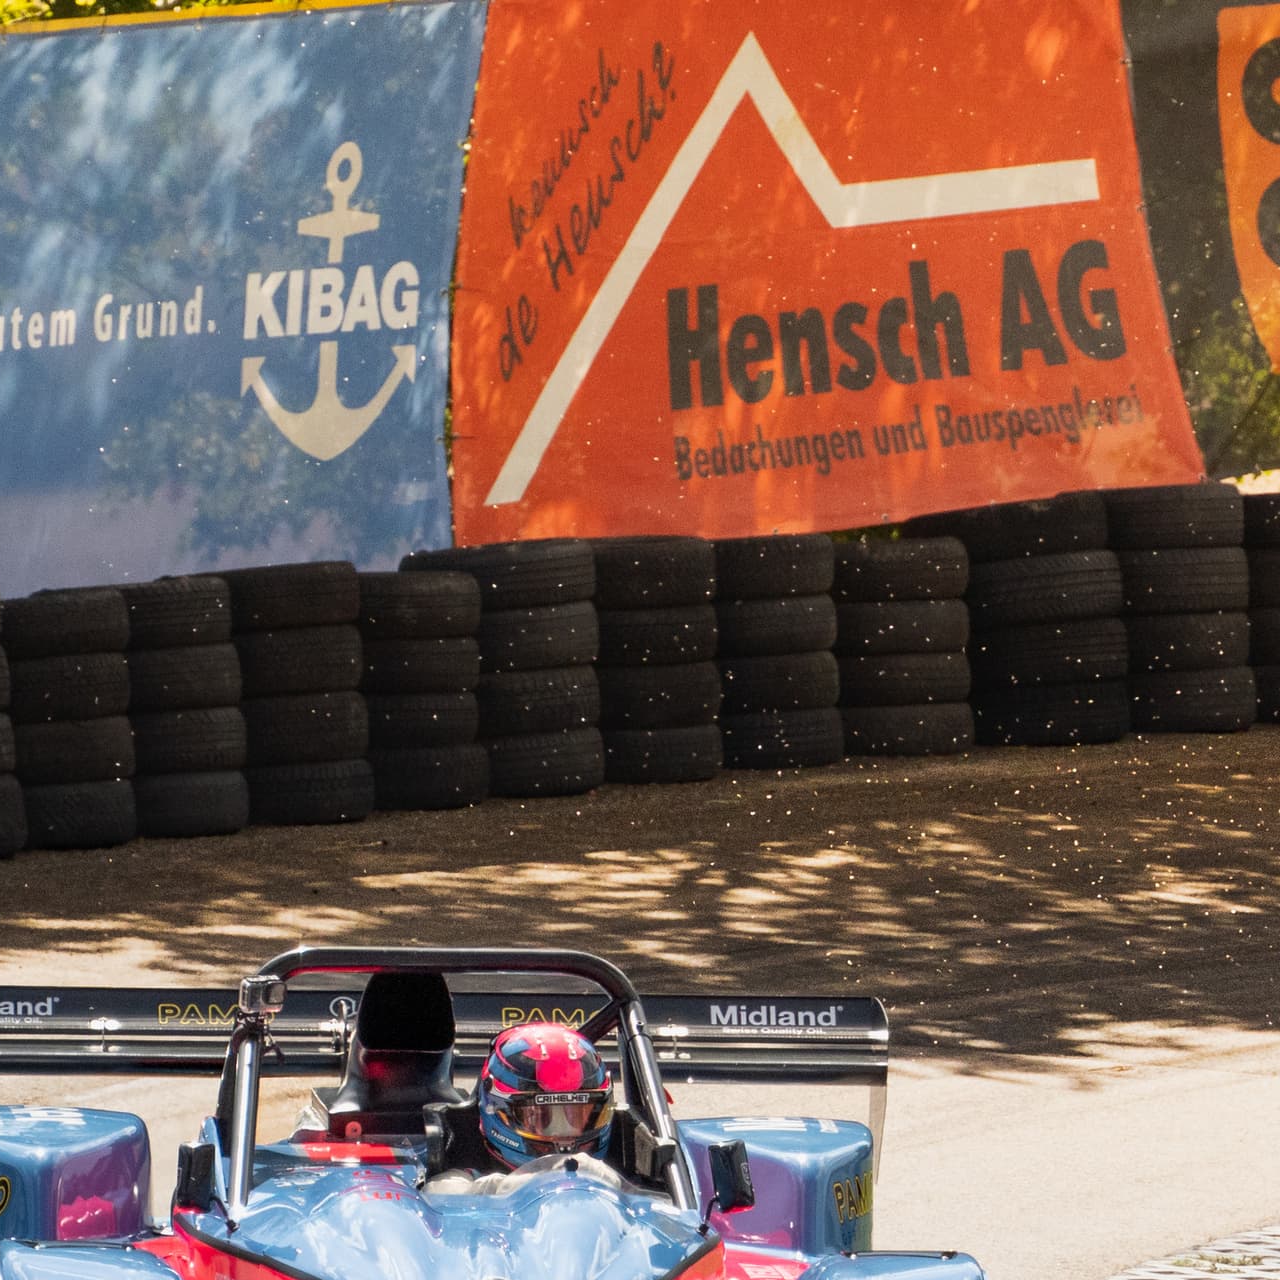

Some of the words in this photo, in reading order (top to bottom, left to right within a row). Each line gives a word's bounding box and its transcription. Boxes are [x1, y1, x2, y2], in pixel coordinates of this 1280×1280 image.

[94, 286, 217, 343] Grund.
[243, 260, 421, 340] KIBAG
[665, 259, 971, 411] Hensch
[999, 239, 1127, 371] AG
[499, 293, 539, 383] de
[673, 425, 865, 481] Bedachungen
[873, 404, 928, 456] und
[933, 384, 1145, 451] Bauspenglerei
[158, 1003, 275, 1025] PAM
[502, 1007, 601, 1029] PAM
[710, 1005, 837, 1026] Midland
